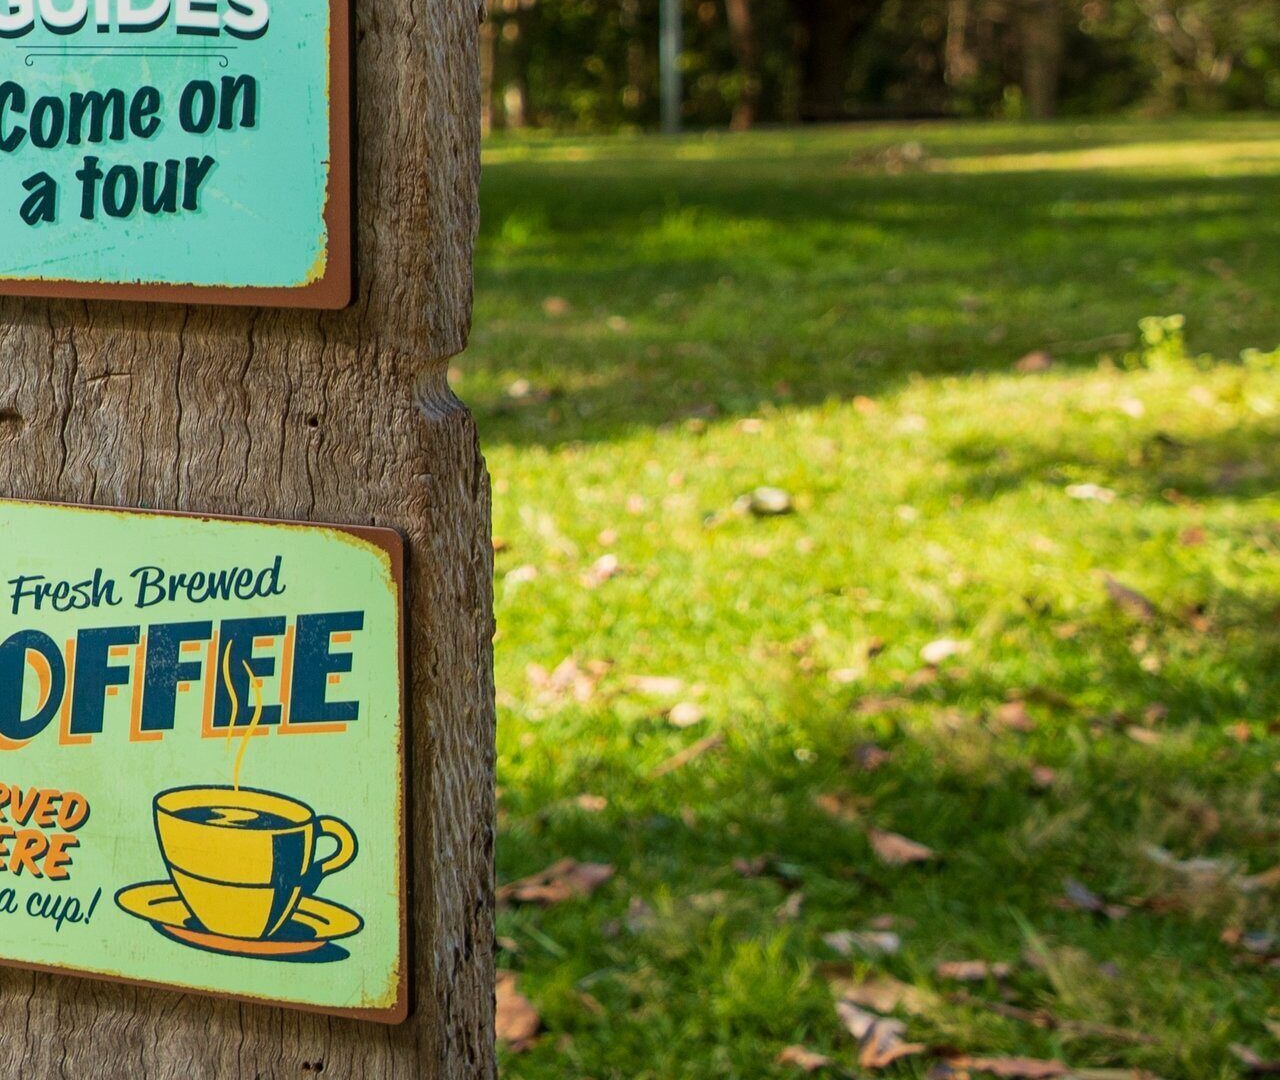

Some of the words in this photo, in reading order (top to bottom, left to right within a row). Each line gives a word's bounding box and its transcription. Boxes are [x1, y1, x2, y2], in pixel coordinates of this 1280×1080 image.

[178, 73, 257, 134] on
[18, 171, 57, 226] a
[76, 152, 216, 220] tour
[8, 567, 122, 615] Fresh
[130, 555, 286, 609] Brewed
[26, 886, 102, 932] cup!
